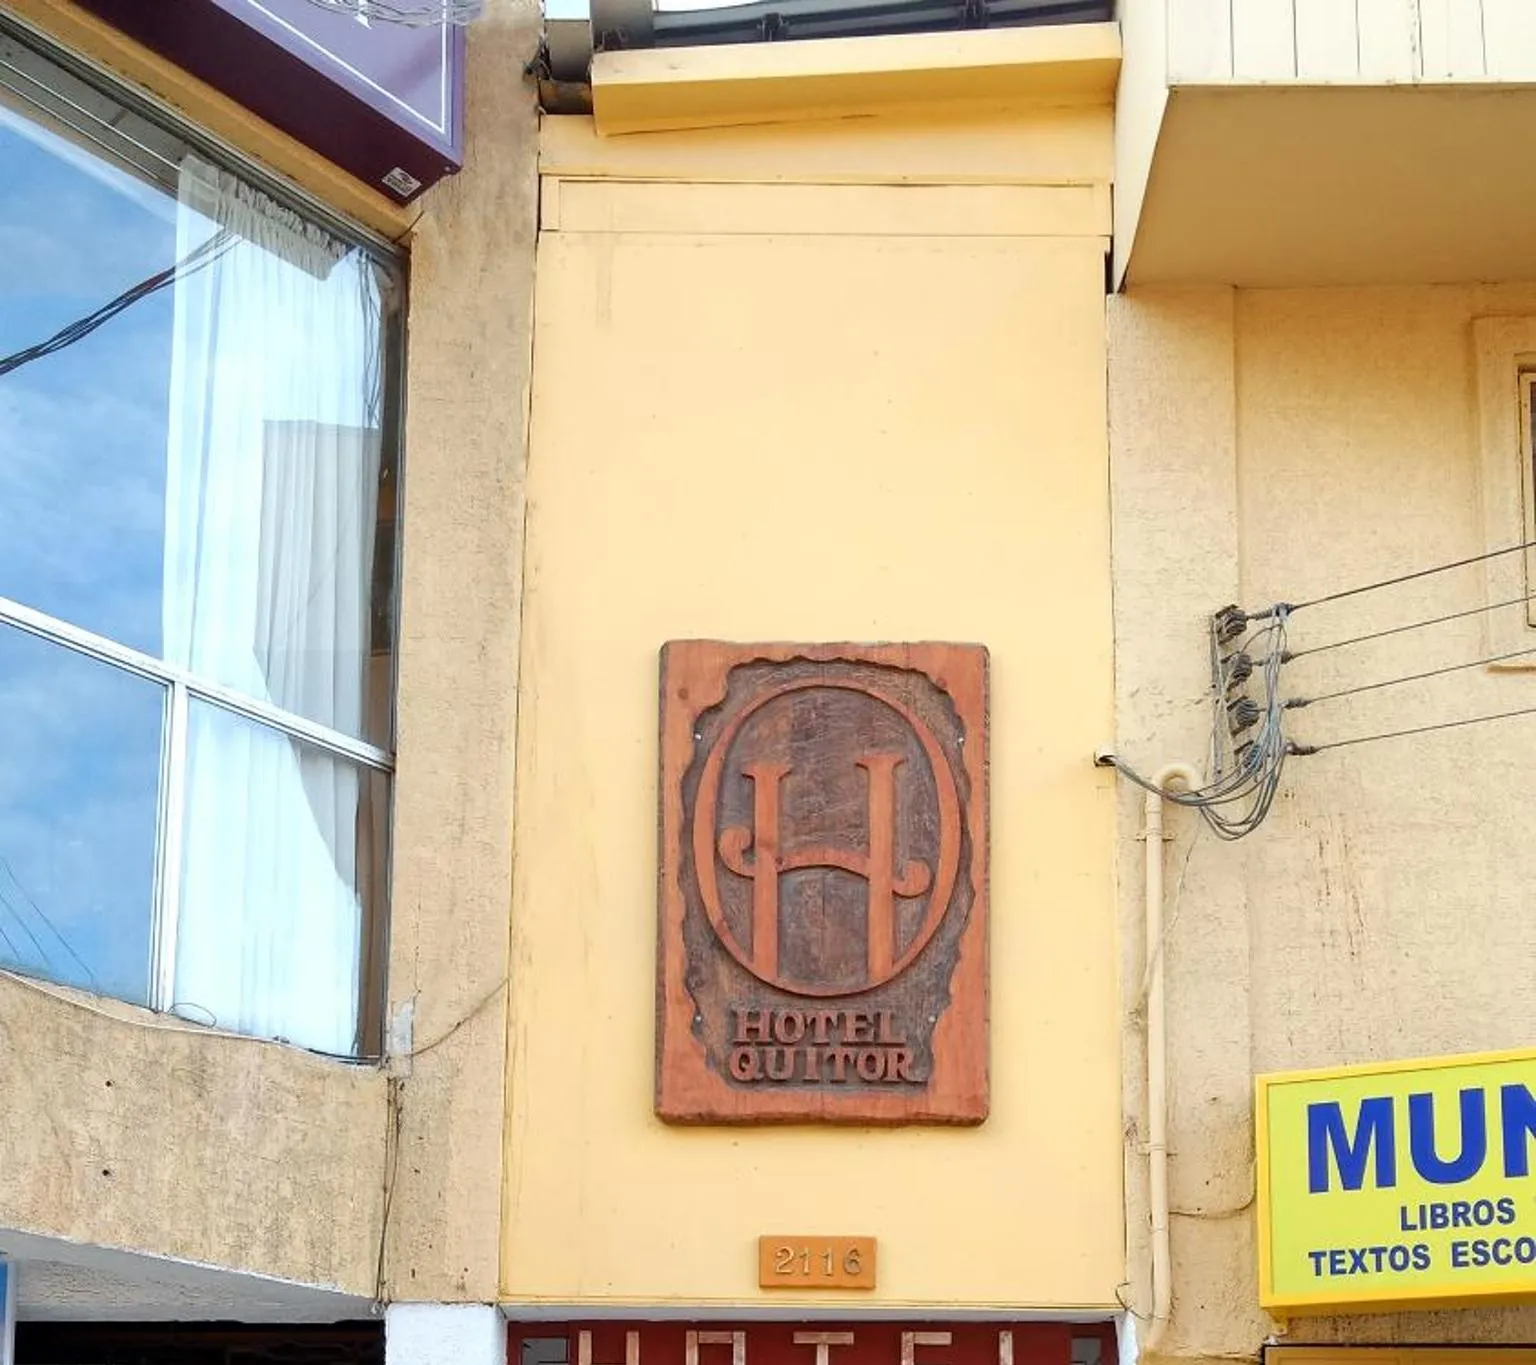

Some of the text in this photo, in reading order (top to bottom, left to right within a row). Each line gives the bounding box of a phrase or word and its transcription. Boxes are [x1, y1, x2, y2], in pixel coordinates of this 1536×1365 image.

[732, 1008, 906, 1046] HOTEL
[729, 1046, 929, 1084] QUITOR
[1400, 1198, 1515, 1231] LIBROS
[775, 1244, 862, 1277] 2116
[1308, 1237, 1536, 1276] TEXTOS ESCO
